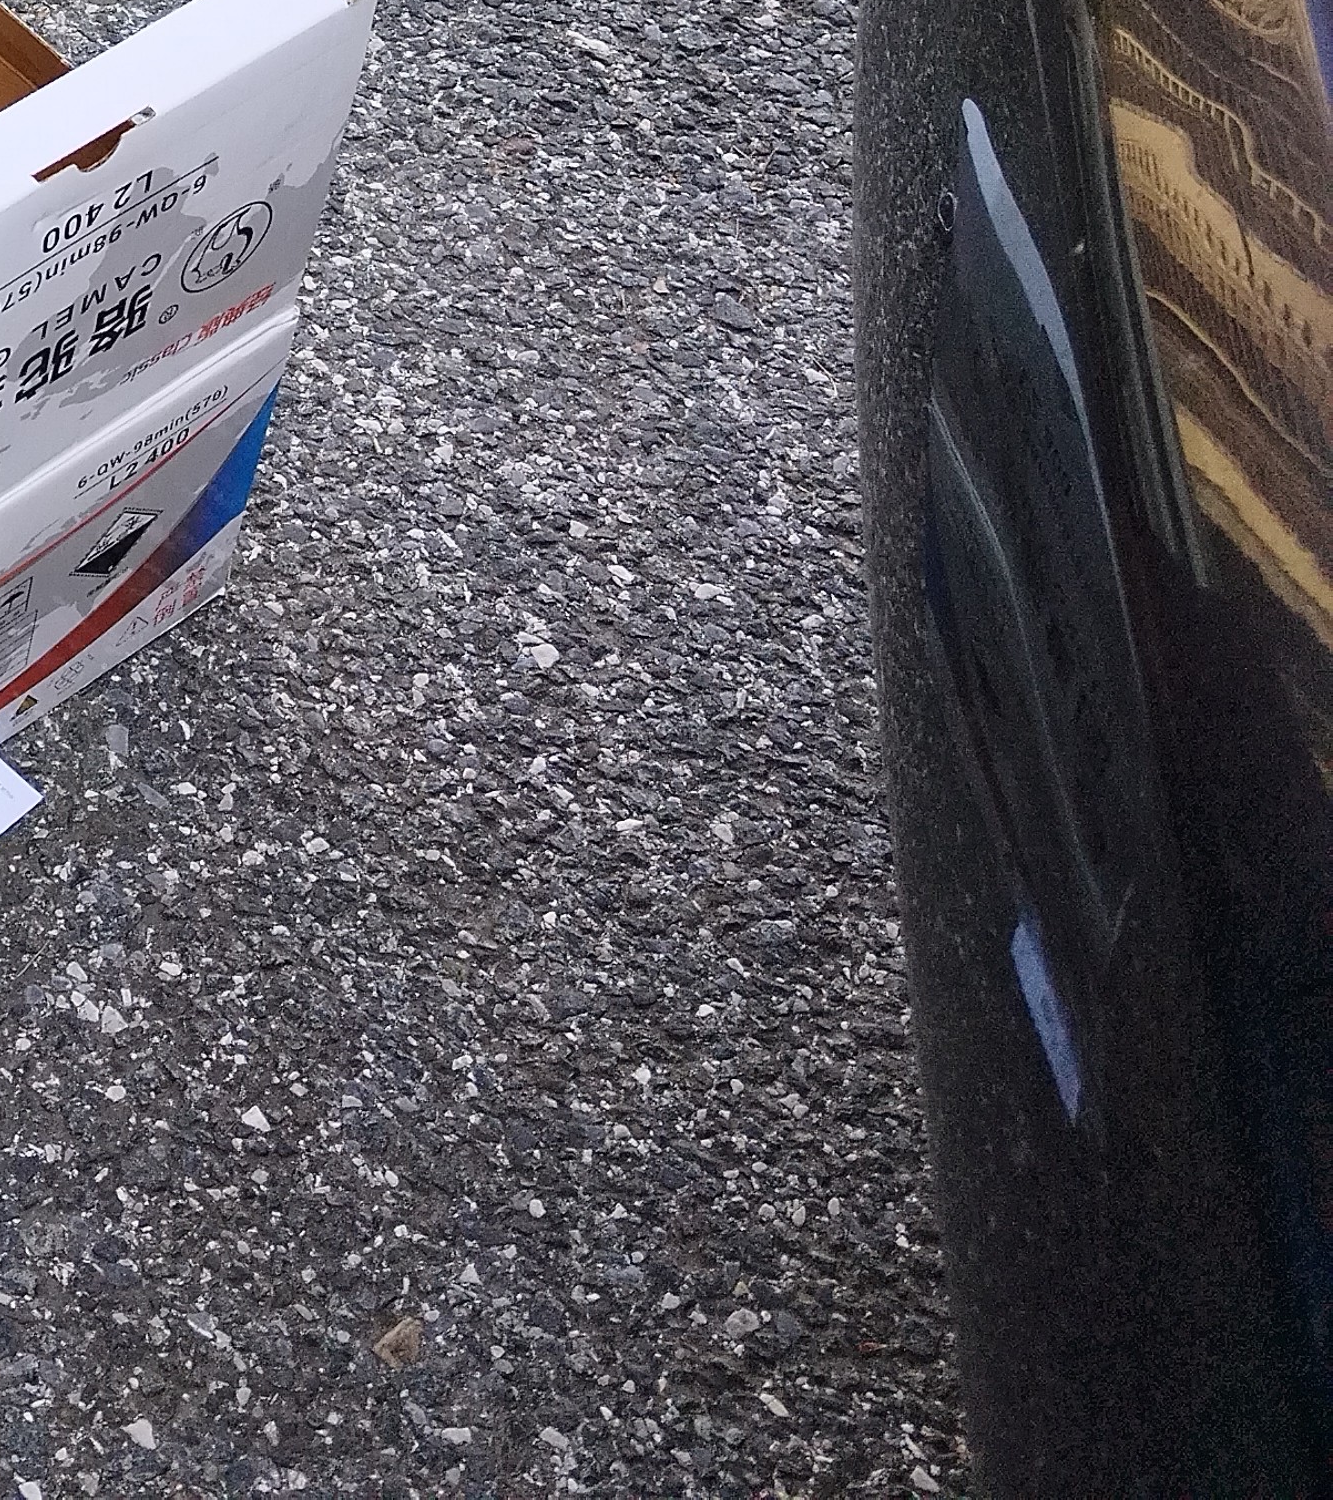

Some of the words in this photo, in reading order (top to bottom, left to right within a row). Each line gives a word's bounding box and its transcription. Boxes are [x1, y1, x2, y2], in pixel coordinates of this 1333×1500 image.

[114, 171, 153, 201] L2
[43, 202, 104, 252] 400
[32, 253, 161, 337] CAMEL
[197, 283, 275, 342] 经典版
[120, 332, 193, 384] Classic
[78, 385, 228, 489] 6-QW-98min(570)
[109, 462, 138, 491] L2
[145, 427, 190, 465] 400
